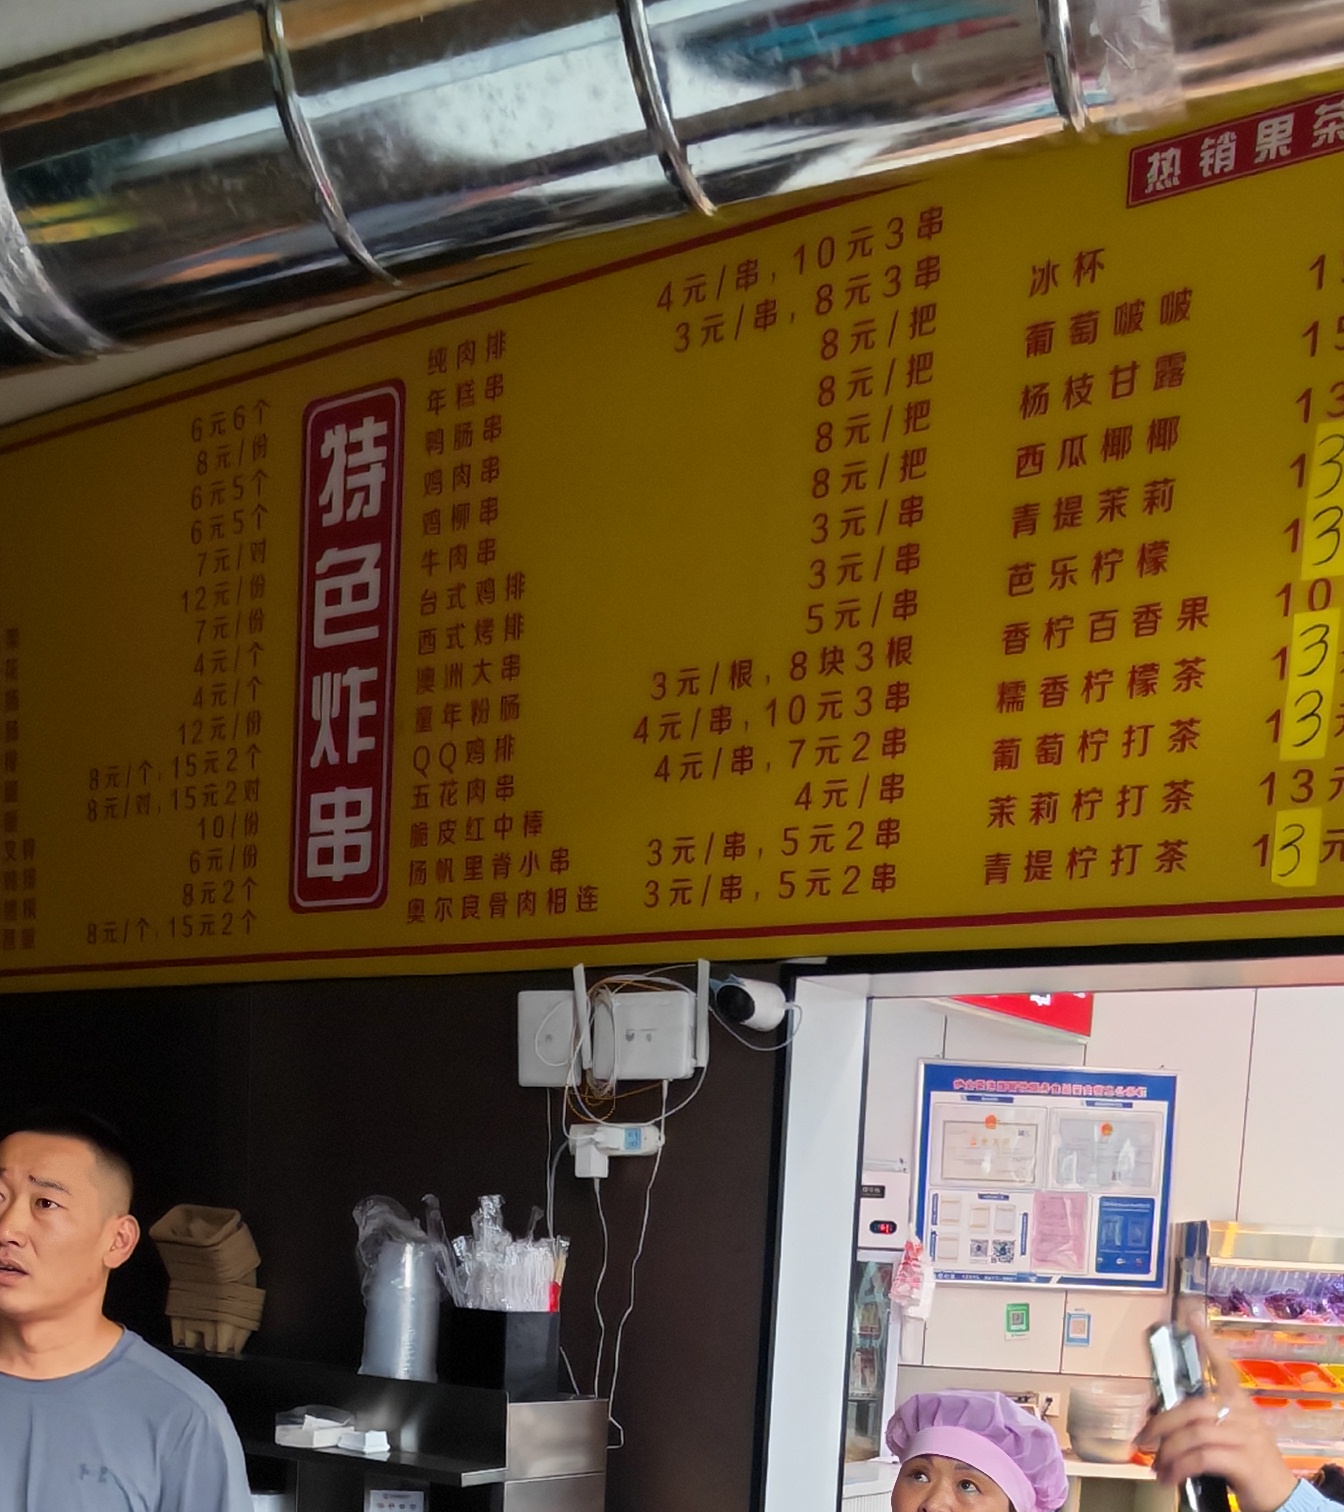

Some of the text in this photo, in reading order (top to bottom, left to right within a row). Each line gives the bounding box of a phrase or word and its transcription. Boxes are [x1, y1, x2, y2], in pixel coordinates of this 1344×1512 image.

[1029, 248, 1106, 298] 冰杯
[820, 302, 937, 361] 8元/把
[1025, 287, 1194, 359] 葡萄啵啵
[1020, 352, 1187, 420] 杨枝甘露
[422, 350, 935, 497] 鸡肉串 8元/把
[815, 398, 931, 453] 8元/把
[1015, 416, 1181, 480] 西瓜椰椰
[420, 446, 928, 576] 牛肉串 8元/把
[1011, 477, 1176, 539] 青提茉莉
[419, 494, 925, 617] 台式鸡排 3元/串
[808, 541, 921, 590] 3元/串
[1006, 540, 1170, 598] 芭乐柠檬
[305, 415, 388, 883] 特色炸串
[415, 588, 919, 696] 澳洲大串 5元/串
[1001, 596, 1209, 658] 香柠百香果
[996, 657, 1207, 715] 糯香柠檬茶
[412, 734, 516, 779] QQ鸡排
[991, 717, 1201, 772] 葡萄柠打茶
[410, 776, 515, 811] 五花肉串
[794, 772, 906, 812] 4元/串
[987, 779, 1195, 829] 茉莉柠打茶
[982, 839, 1189, 886] 青提柠打茶
[406, 884, 600, 925] 奥尔良骨肉相连
